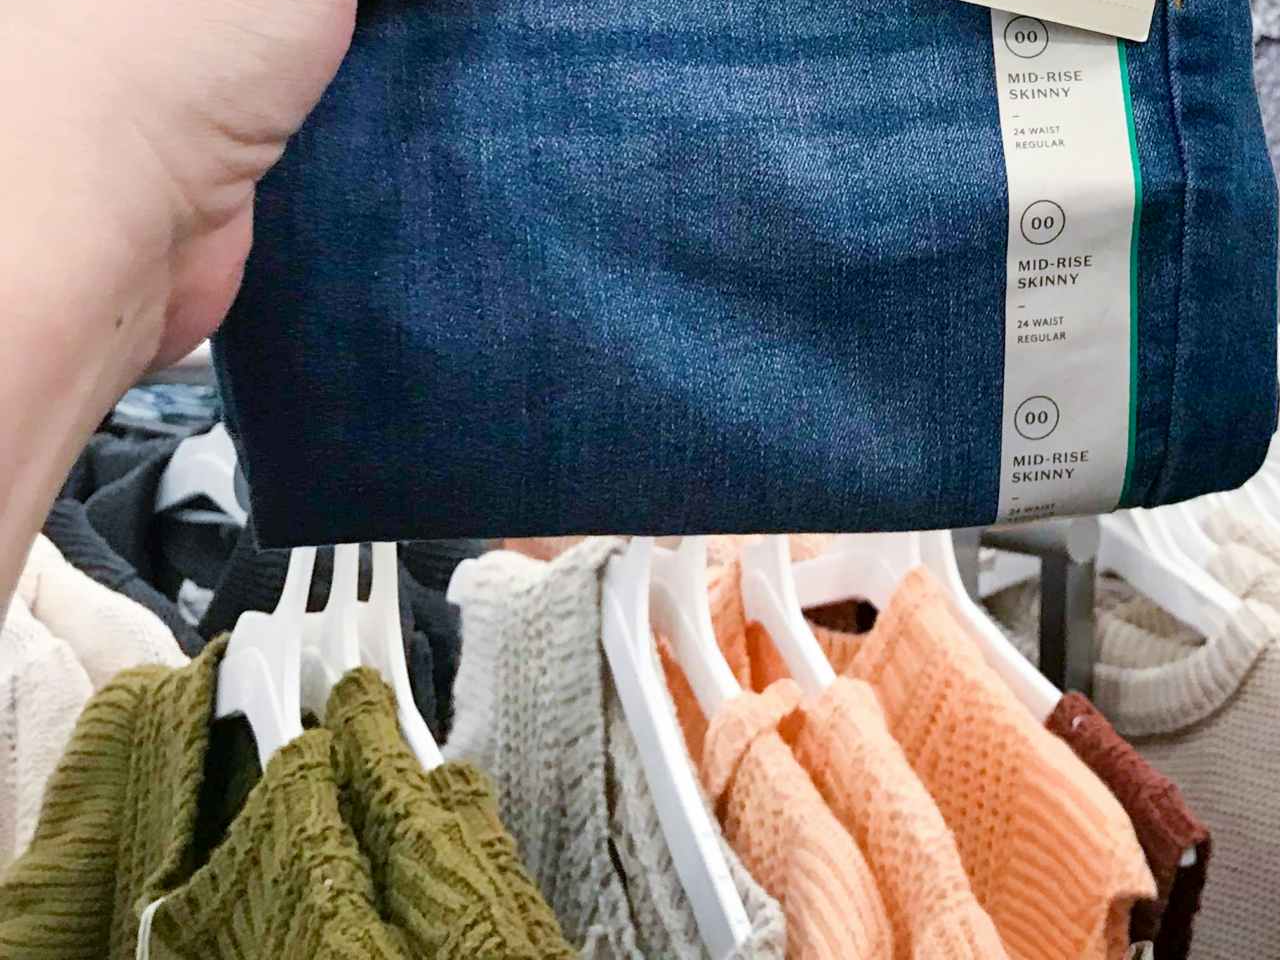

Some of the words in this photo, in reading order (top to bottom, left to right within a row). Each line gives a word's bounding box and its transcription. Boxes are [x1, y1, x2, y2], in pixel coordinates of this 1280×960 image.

[1014, 30, 1038, 44] 00
[1007, 70, 1083, 84] MID-RISE
[1008, 87, 1072, 100] SKINNY
[1013, 127, 1026, 136] 24
[1028, 126, 1061, 136] WAIST
[1015, 139, 1065, 150] REGULAR
[1031, 215, 1055, 231] 00
[1018, 255, 1093, 272] MID-RISE
[1017, 272, 1080, 289] SKINNY
[1017, 319, 1030, 329] 24
[1031, 316, 1065, 328] WAIST
[1017, 331, 1067, 344] REGULAR
[1024, 410, 1049, 425] 00
[1012, 450, 1089, 468] MID-RISE
[1011, 468, 1076, 484] SKINNY
